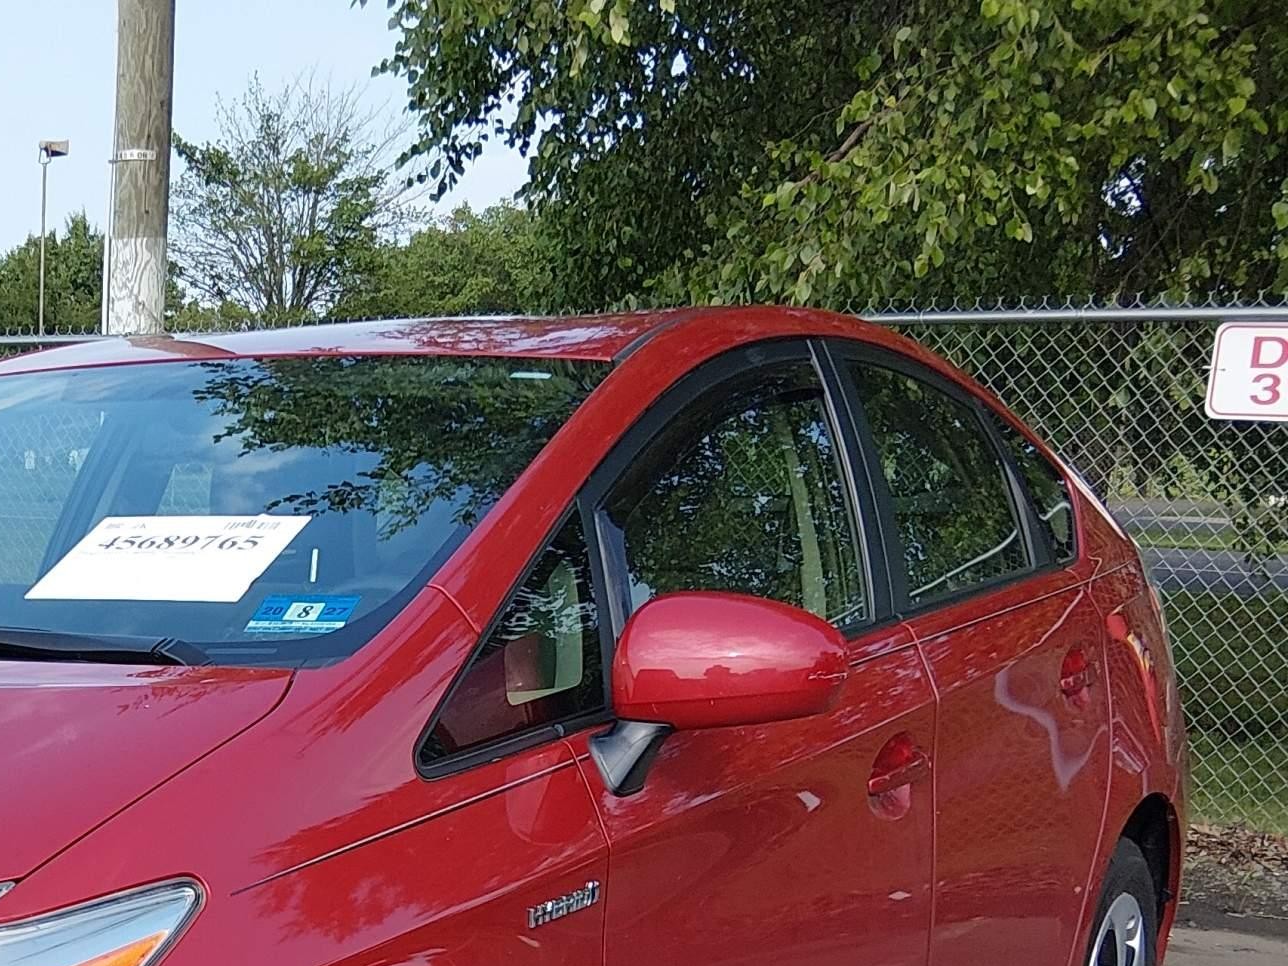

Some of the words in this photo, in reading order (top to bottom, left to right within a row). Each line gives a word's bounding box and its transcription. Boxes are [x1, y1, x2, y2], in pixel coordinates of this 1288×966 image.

[1250, 373, 1282, 406] 3
[98, 534, 265, 551] 45689765
[261, 606, 284, 616] 20
[296, 605, 314, 619] 8
[324, 606, 349, 616] 27
[526, 880, 600, 929] HYBRID
